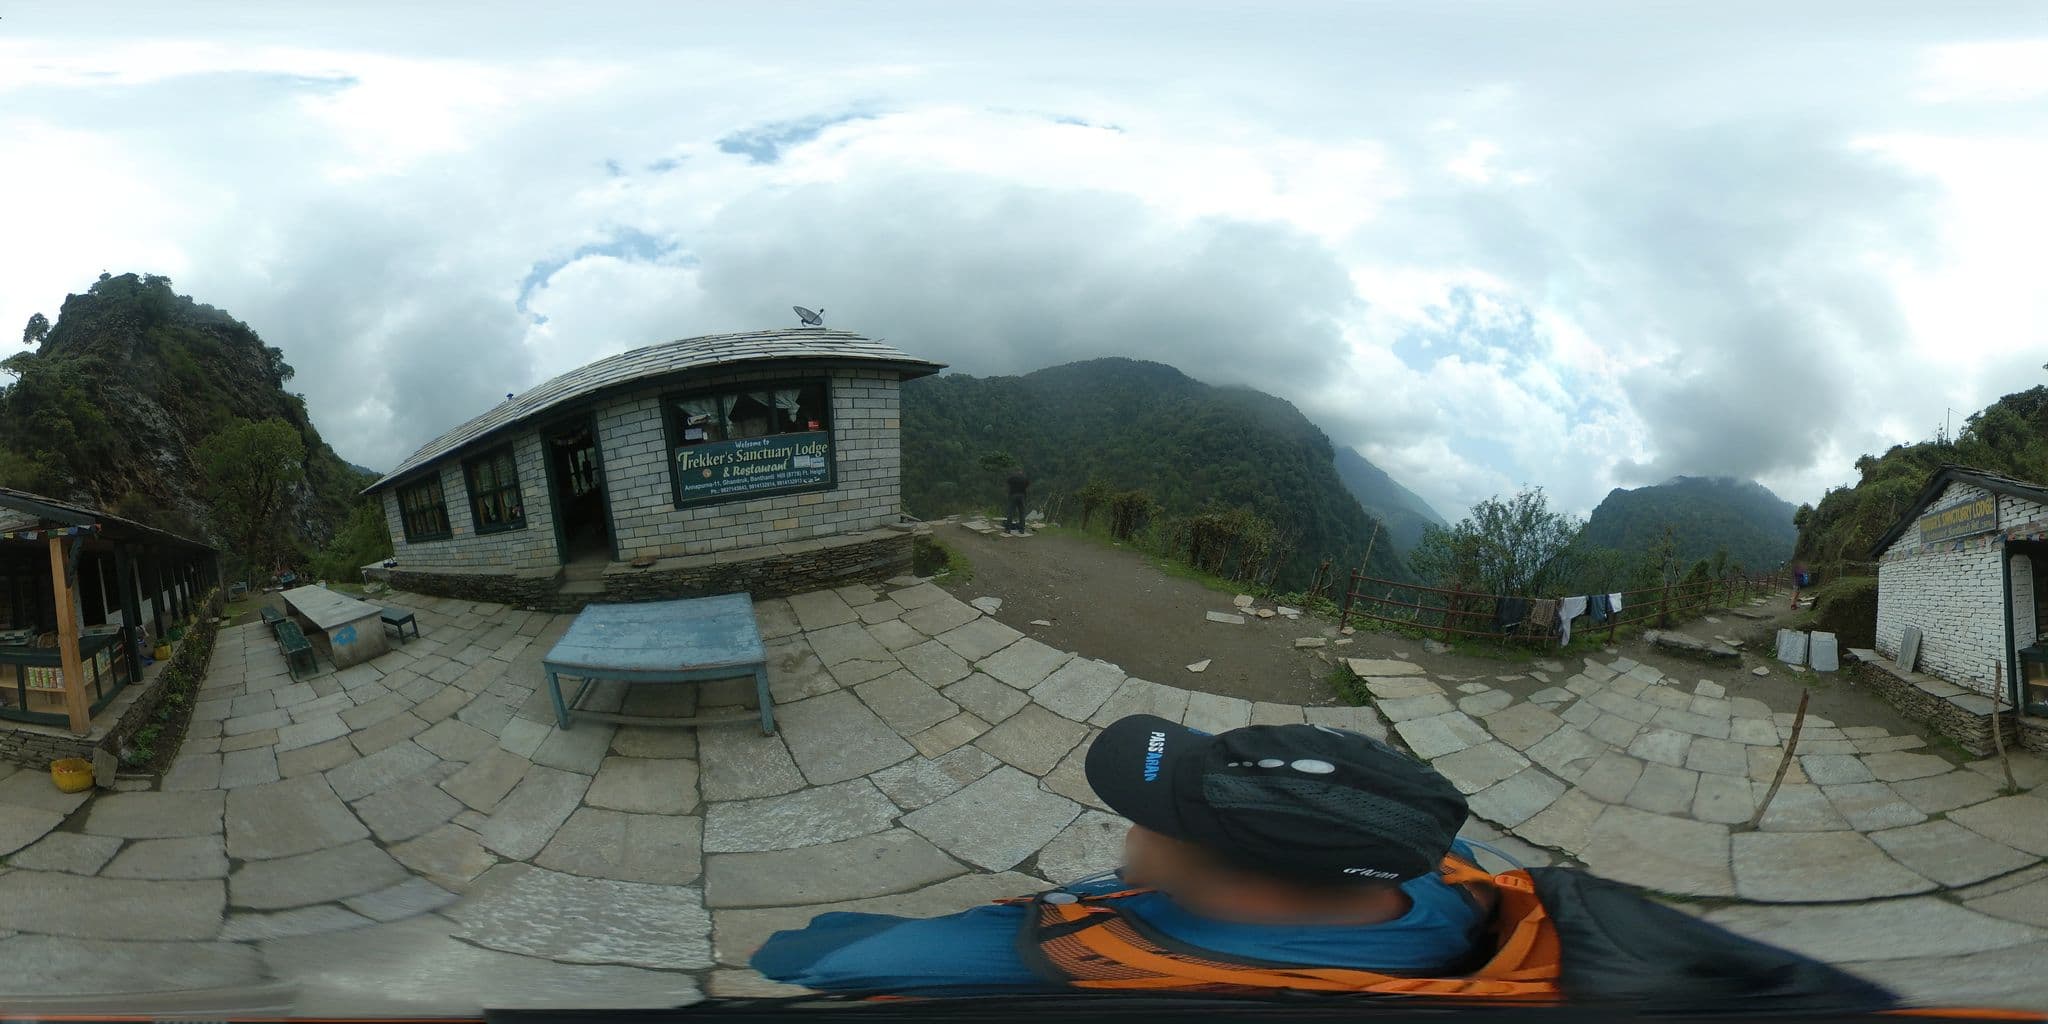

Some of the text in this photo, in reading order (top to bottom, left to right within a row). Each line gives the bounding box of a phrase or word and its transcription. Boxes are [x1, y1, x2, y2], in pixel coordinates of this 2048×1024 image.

[735, 438, 770, 449] Welcome to
[678, 451, 734, 471] Trekker's
[736, 446, 793, 463] Sanctuary
[795, 441, 828, 457] Lodge
[723, 467, 730, 478] &
[733, 459, 788, 477] Restaurant
